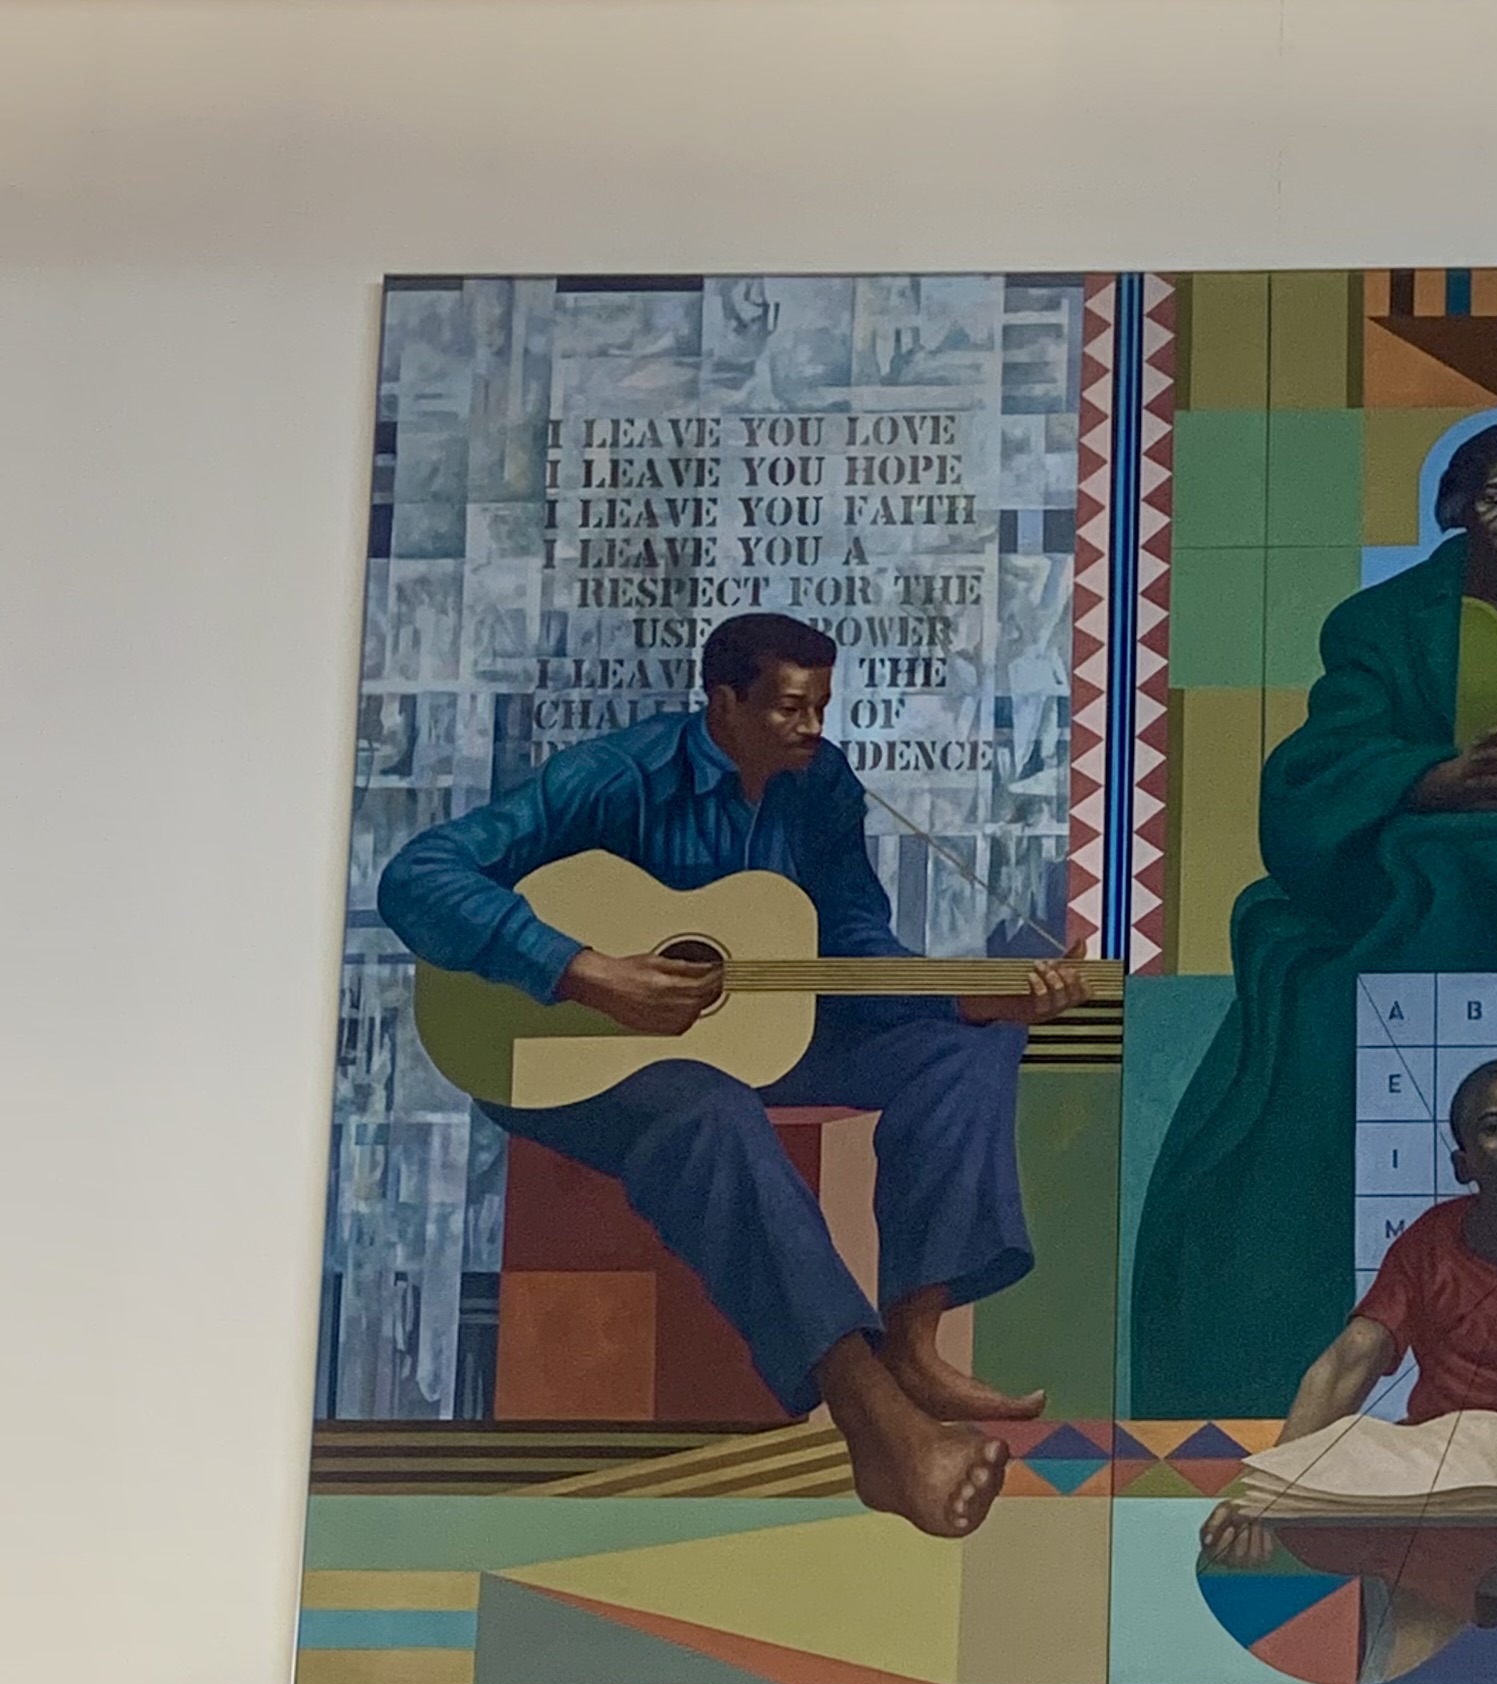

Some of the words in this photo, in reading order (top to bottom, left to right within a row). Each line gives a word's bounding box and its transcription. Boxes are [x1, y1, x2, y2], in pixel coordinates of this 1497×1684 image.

[549, 418, 564, 449] I
[583, 417, 721, 449] LEAVE
[740, 416, 825, 448] YOU
[845, 414, 956, 446] LOVE
[546, 459, 562, 489] I
[582, 457, 721, 489] LEAVE
[741, 456, 826, 487] YOU
[844, 454, 963, 486] HOPE
[544, 499, 559, 530] I
[579, 497, 718, 529] LEAVE
[738, 496, 823, 527] YOU
[843, 494, 977, 526] FAITH
[543, 538, 557, 569] I
[579, 536, 718, 569] LEAVE
[737, 535, 823, 567] YOU
[842, 535, 870, 566] A
[577, 576, 770, 609] RESPECT
[788, 575, 872, 607] FOR
[893, 574, 982, 606] THE
[536, 658, 550, 690] I
[859, 656, 947, 689] THE
[851, 698, 906, 730] OF
[1388, 1000, 1405, 1021] A
[1467, 1001, 1482, 1020] B
[1389, 1074, 1402, 1093] E
